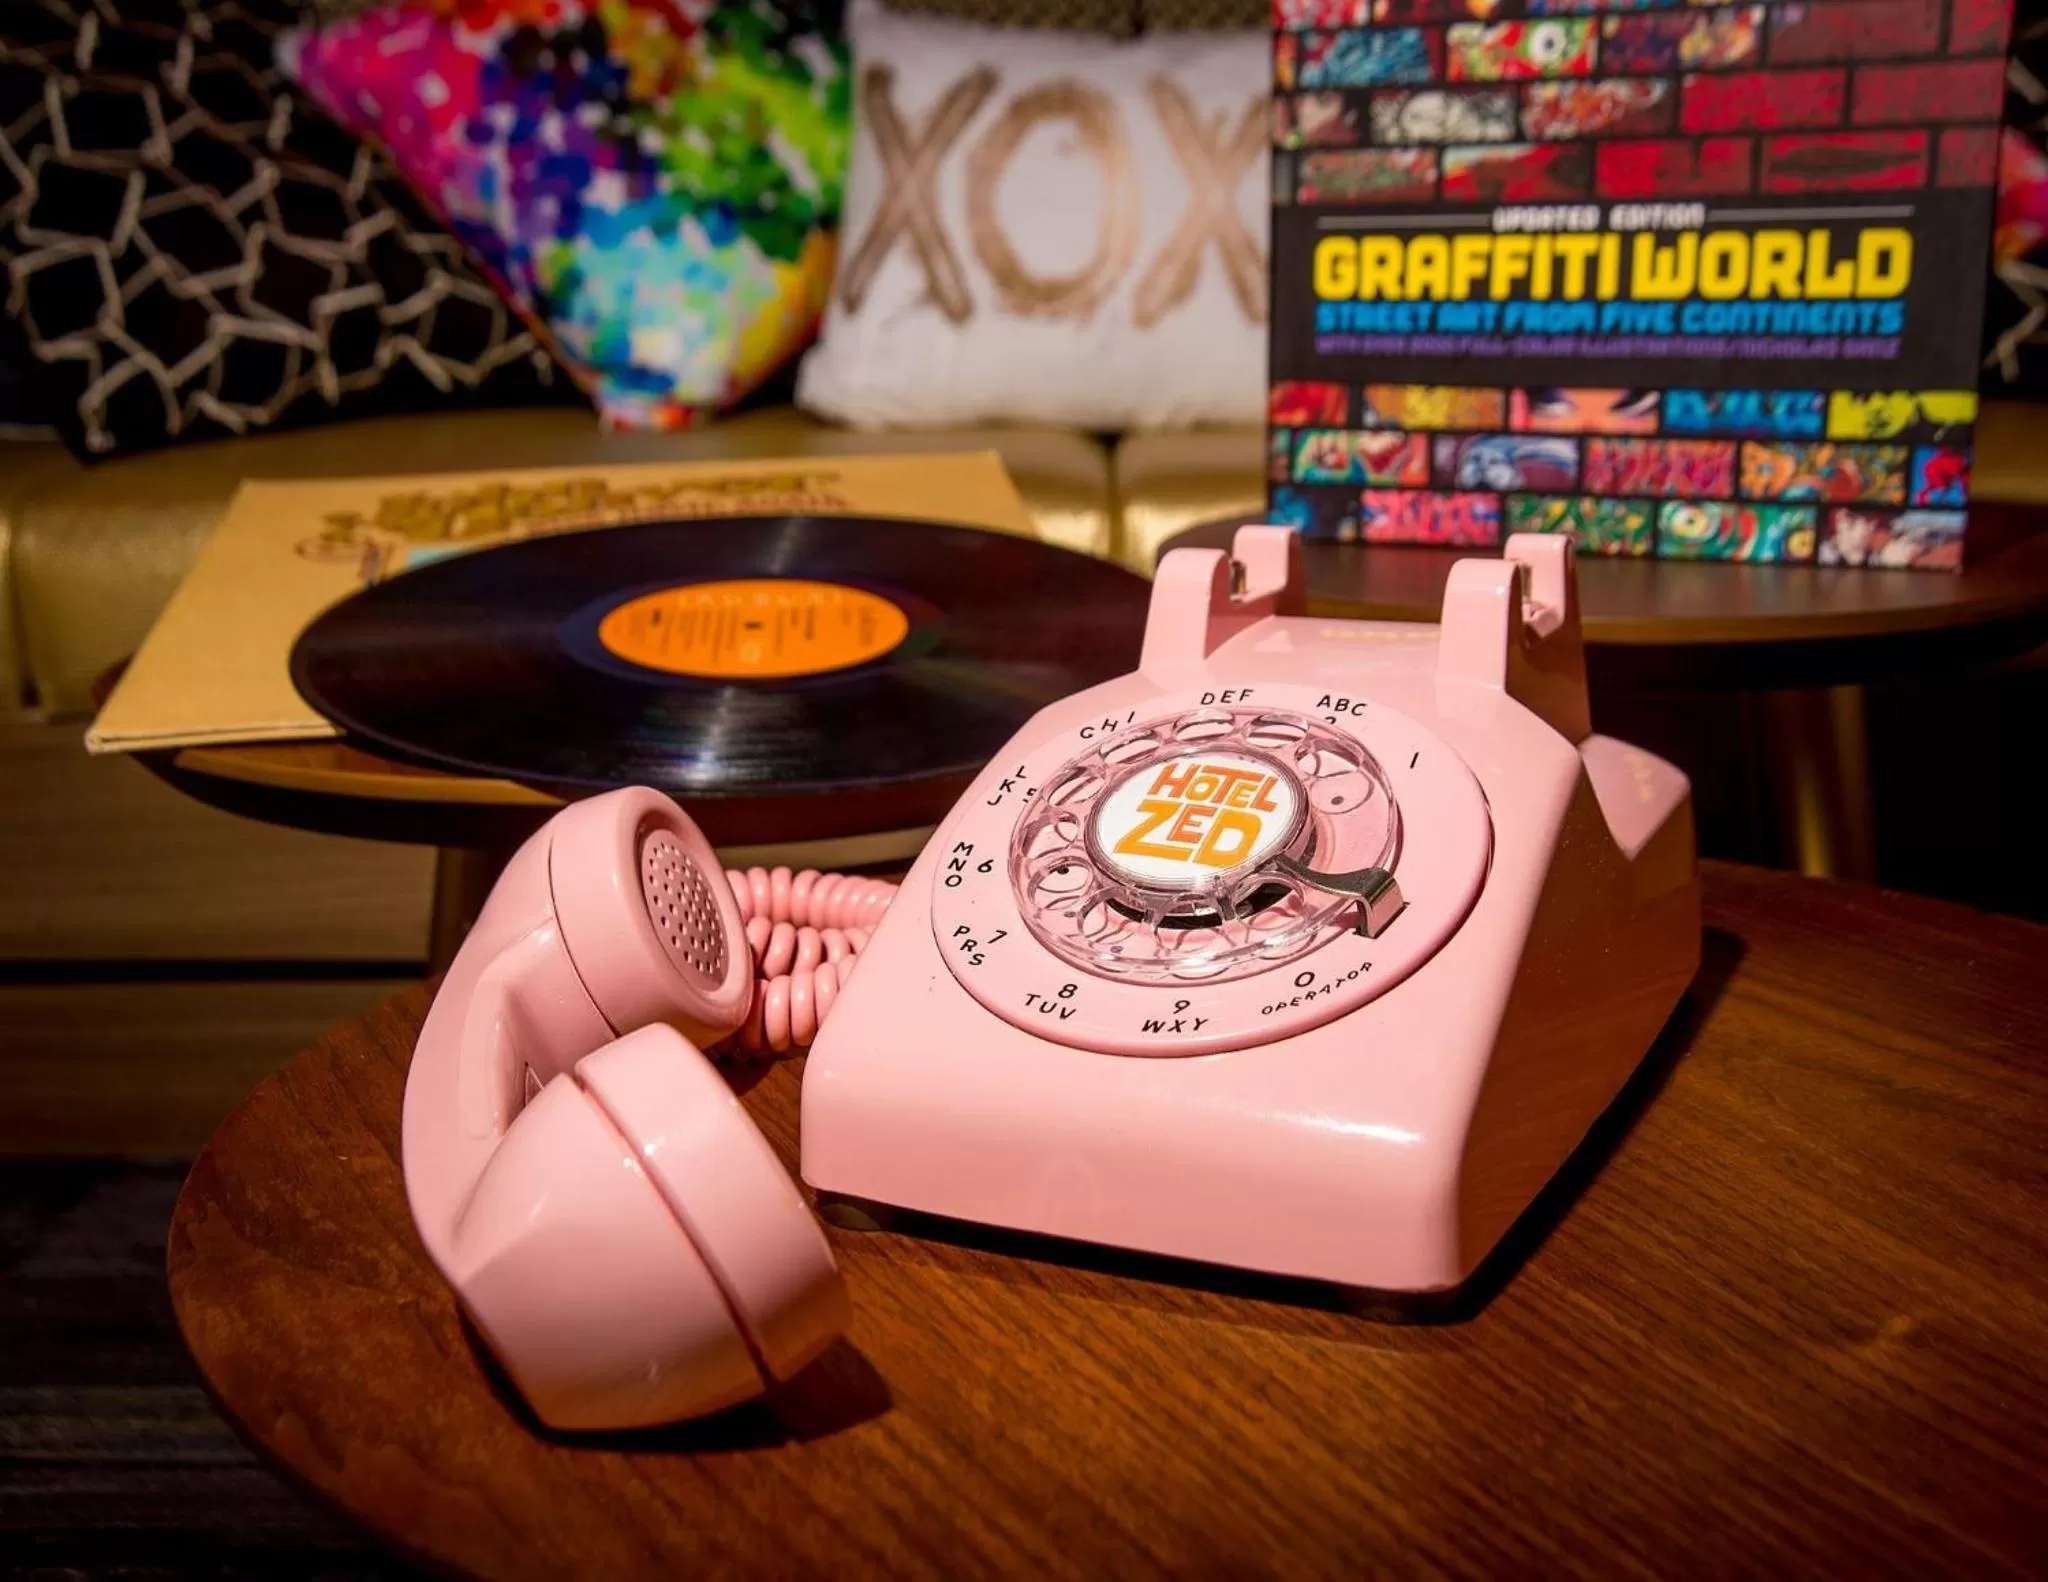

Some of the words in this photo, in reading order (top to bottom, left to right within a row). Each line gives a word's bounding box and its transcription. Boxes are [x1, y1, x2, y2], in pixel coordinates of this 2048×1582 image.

[846, 63, 1269, 329] XOX
[1313, 233, 1621, 300] GRAFFITI
[1630, 227, 1913, 300] WORLD
[1315, 300, 1433, 334] STREET
[1502, 300, 1598, 334] FROM
[1601, 301, 1675, 334] FIVE
[1681, 301, 1904, 335] CONTINENTS
[1200, 688, 1254, 706] DEF
[1316, 694, 1367, 716] ABC
[1080, 711, 1135, 739] GHI
[1147, 762, 1280, 814] HOTEL
[1113, 799, 1263, 868] ZED
[977, 859, 994, 873] 6
[987, 929, 1008, 945] 7
[1057, 983, 1078, 999] 8
[1261, 961, 1373, 1015] OPERATOR
[1025, 993, 1077, 1021] TUV
[1172, 999, 1191, 1015] 9
[1141, 1017, 1208, 1034] WXY
